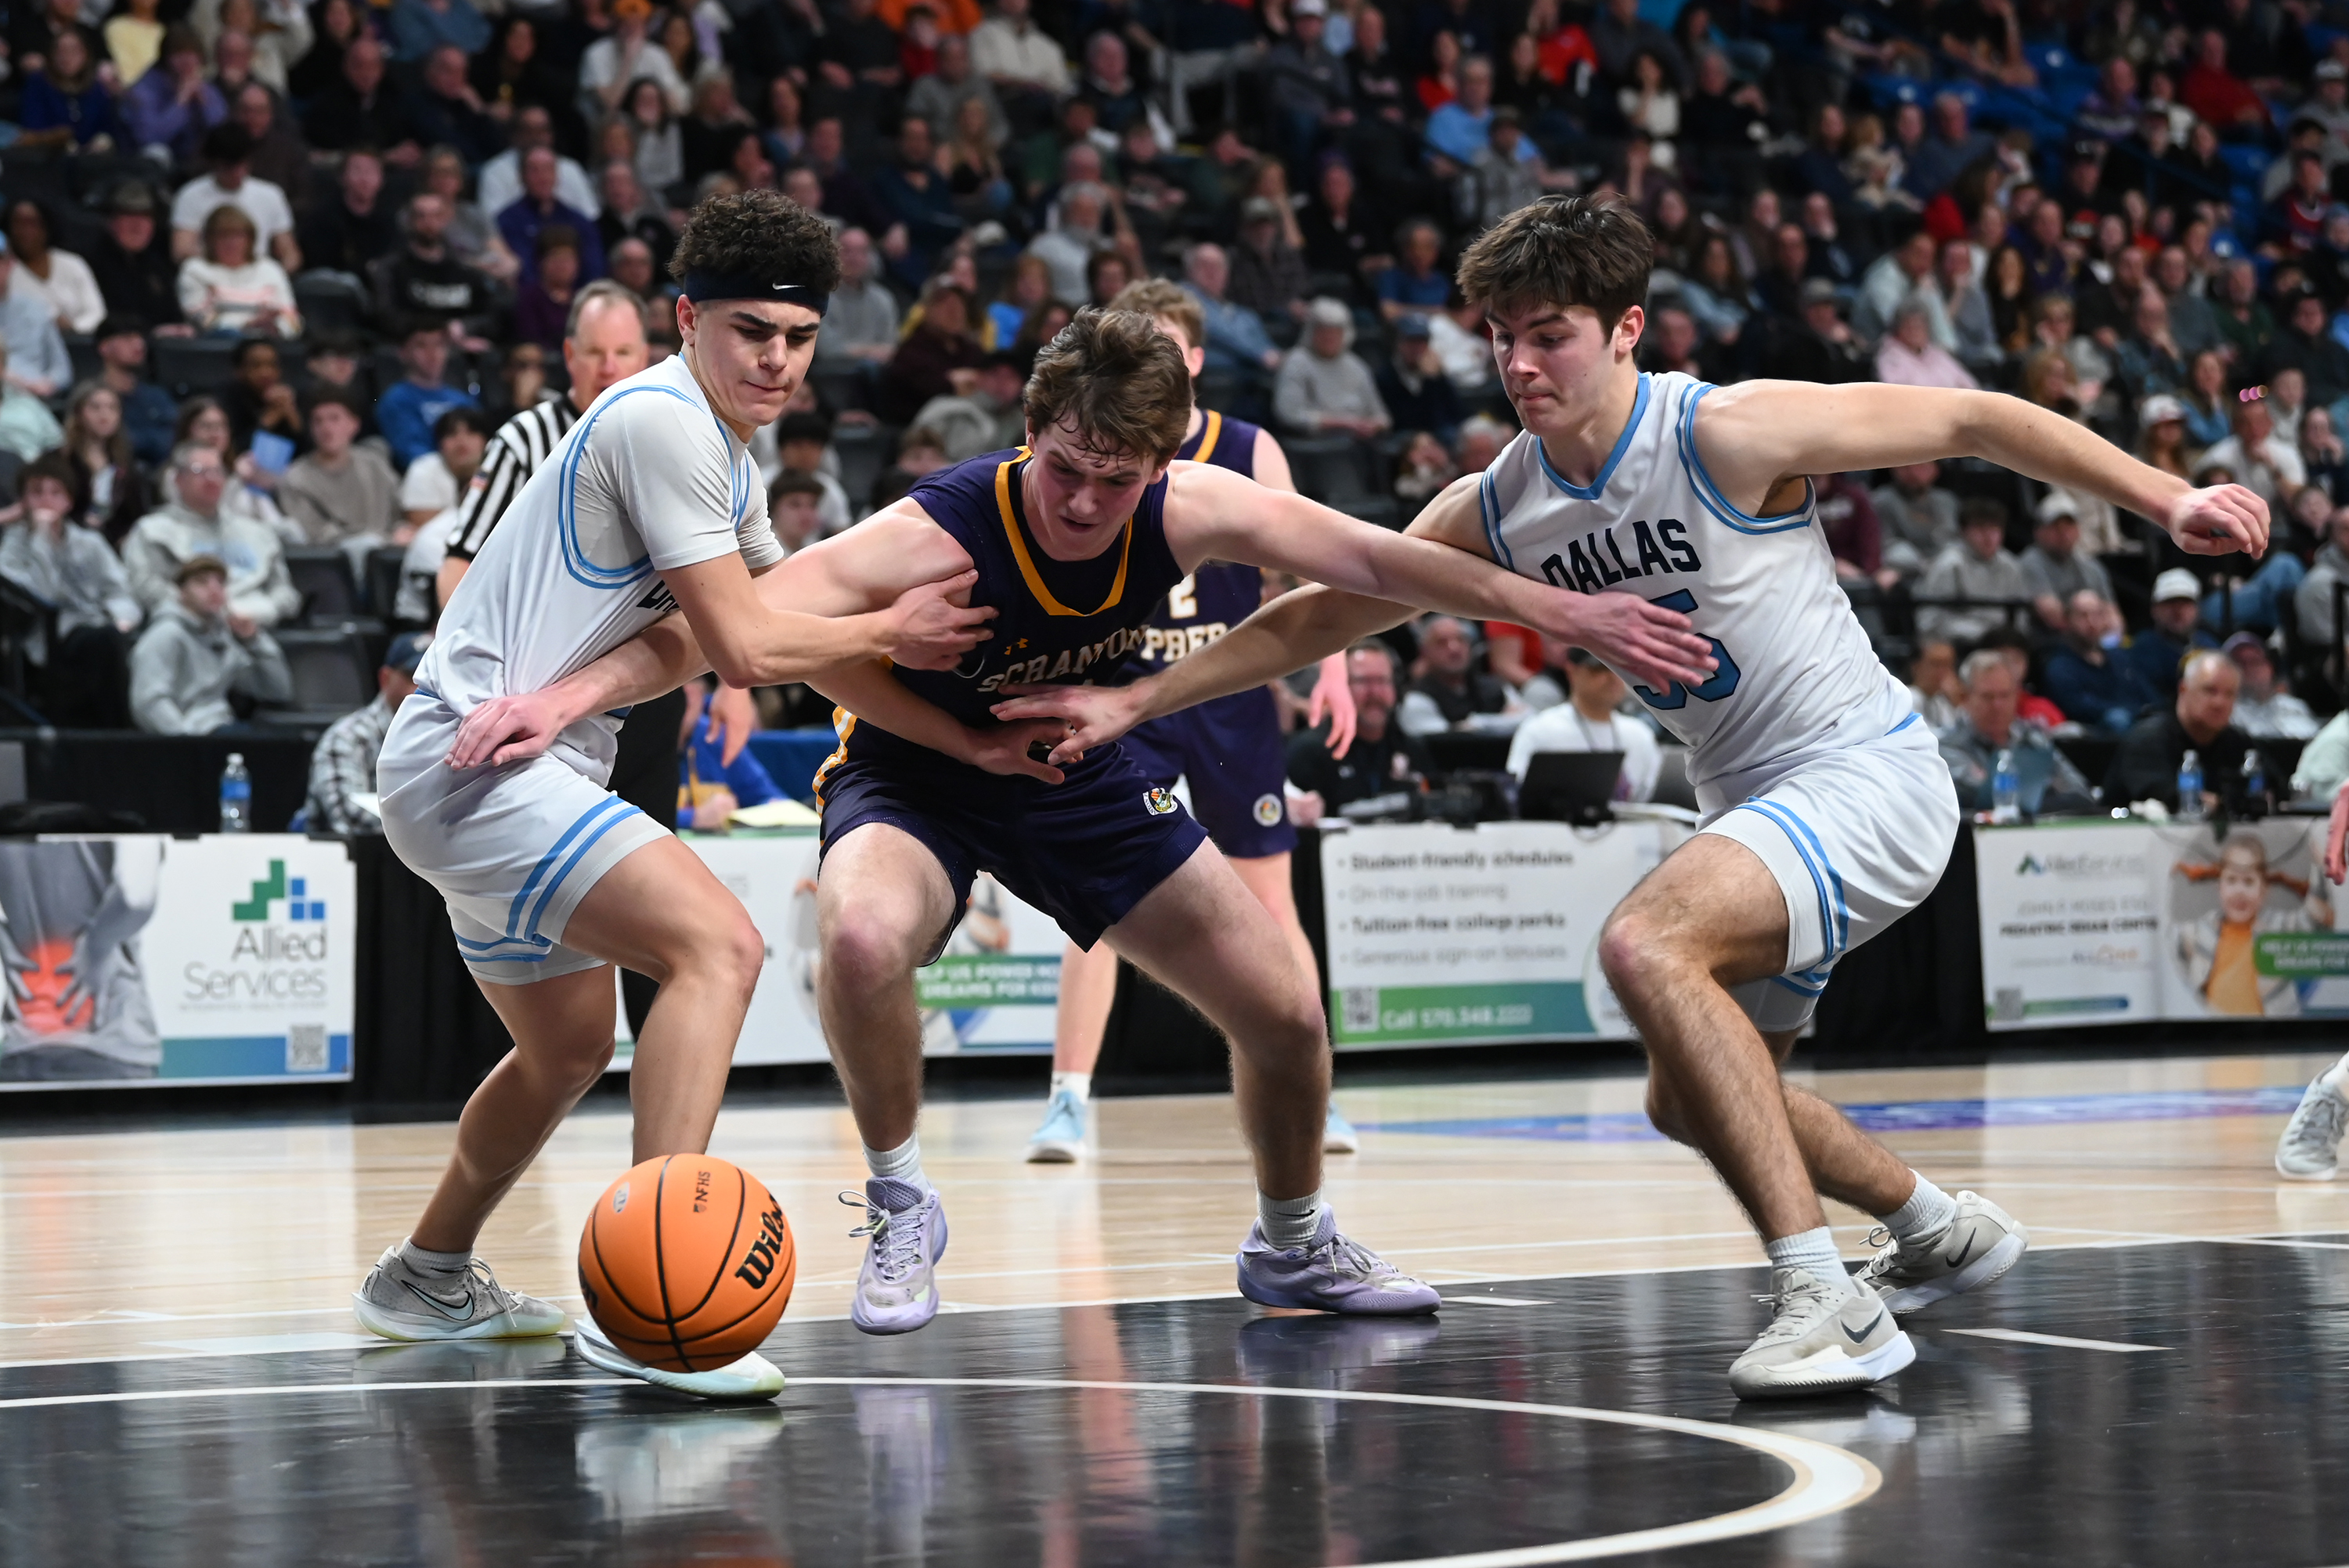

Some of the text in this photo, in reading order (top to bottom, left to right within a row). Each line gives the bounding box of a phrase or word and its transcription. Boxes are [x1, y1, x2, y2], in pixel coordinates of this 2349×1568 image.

[1541, 519, 1701, 594] DALLAS
[231, 925, 328, 961] Allied
[183, 961, 328, 1001] Services
[695, 1171, 710, 1202] NFHS
